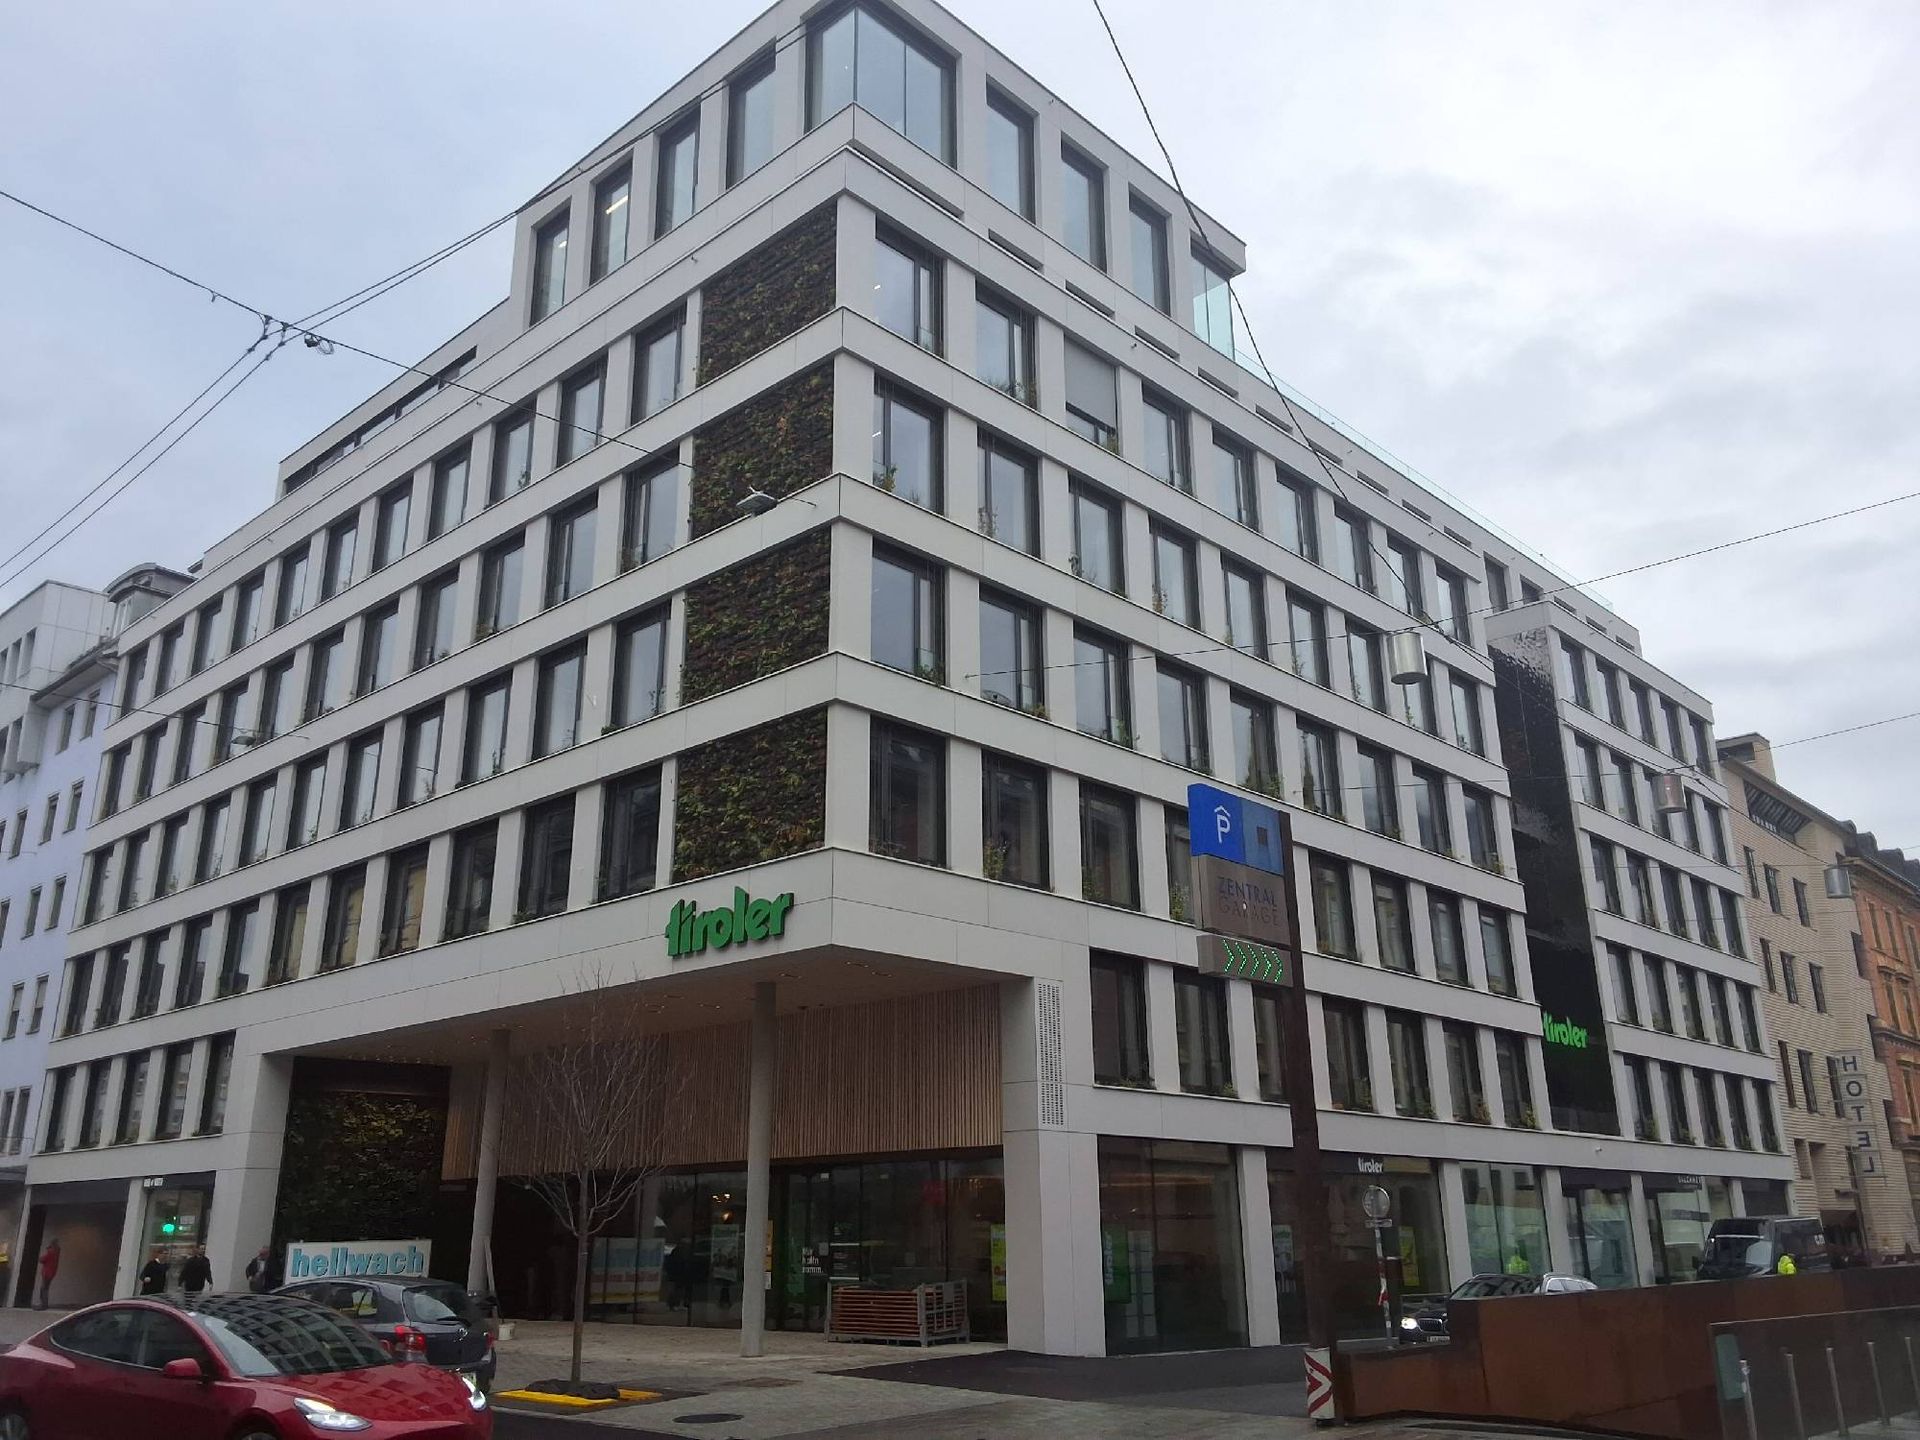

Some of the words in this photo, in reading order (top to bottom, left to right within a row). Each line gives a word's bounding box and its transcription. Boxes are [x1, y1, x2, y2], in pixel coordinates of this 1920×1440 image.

[1216, 815, 1231, 843] P
[1217, 876, 1277, 907] ZENTRAL
[666, 886, 795, 957] tiroler
[1218, 896, 1279, 926] GARAGE
[1543, 1010, 1587, 1048] tiroler
[1358, 1157, 1383, 1173] tiroler
[291, 1245, 424, 1278] hellwach
